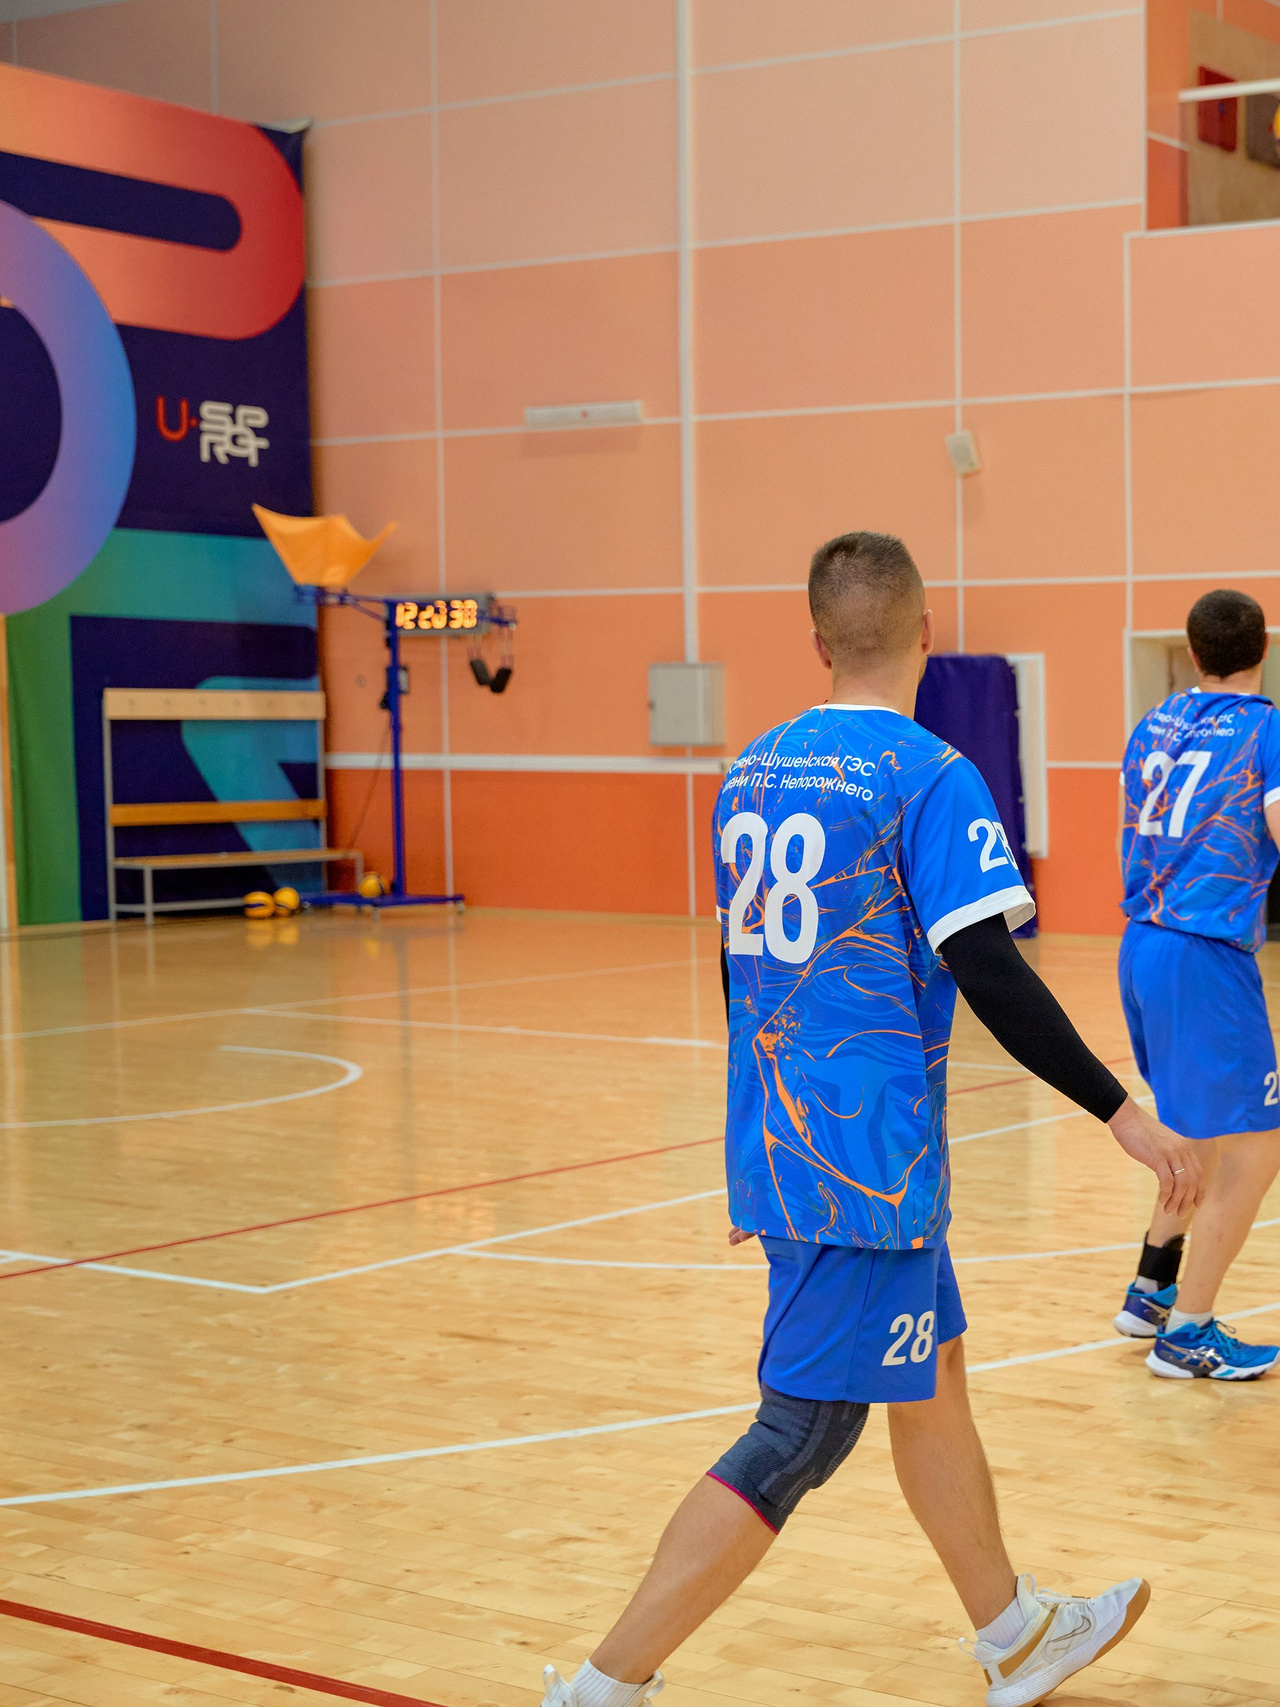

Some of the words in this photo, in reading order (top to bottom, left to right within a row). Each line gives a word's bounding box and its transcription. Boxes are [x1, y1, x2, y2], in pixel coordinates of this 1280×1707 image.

[750, 773, 777, 789] П.С.
[780, 774, 874, 801] Непорожнего
[840, 755, 876, 777] ГЭС
[1138, 751, 1212, 838] 27
[720, 811, 826, 964] 28
[1263, 1069, 1279, 1106] 2
[881, 1310, 935, 1366] 28
